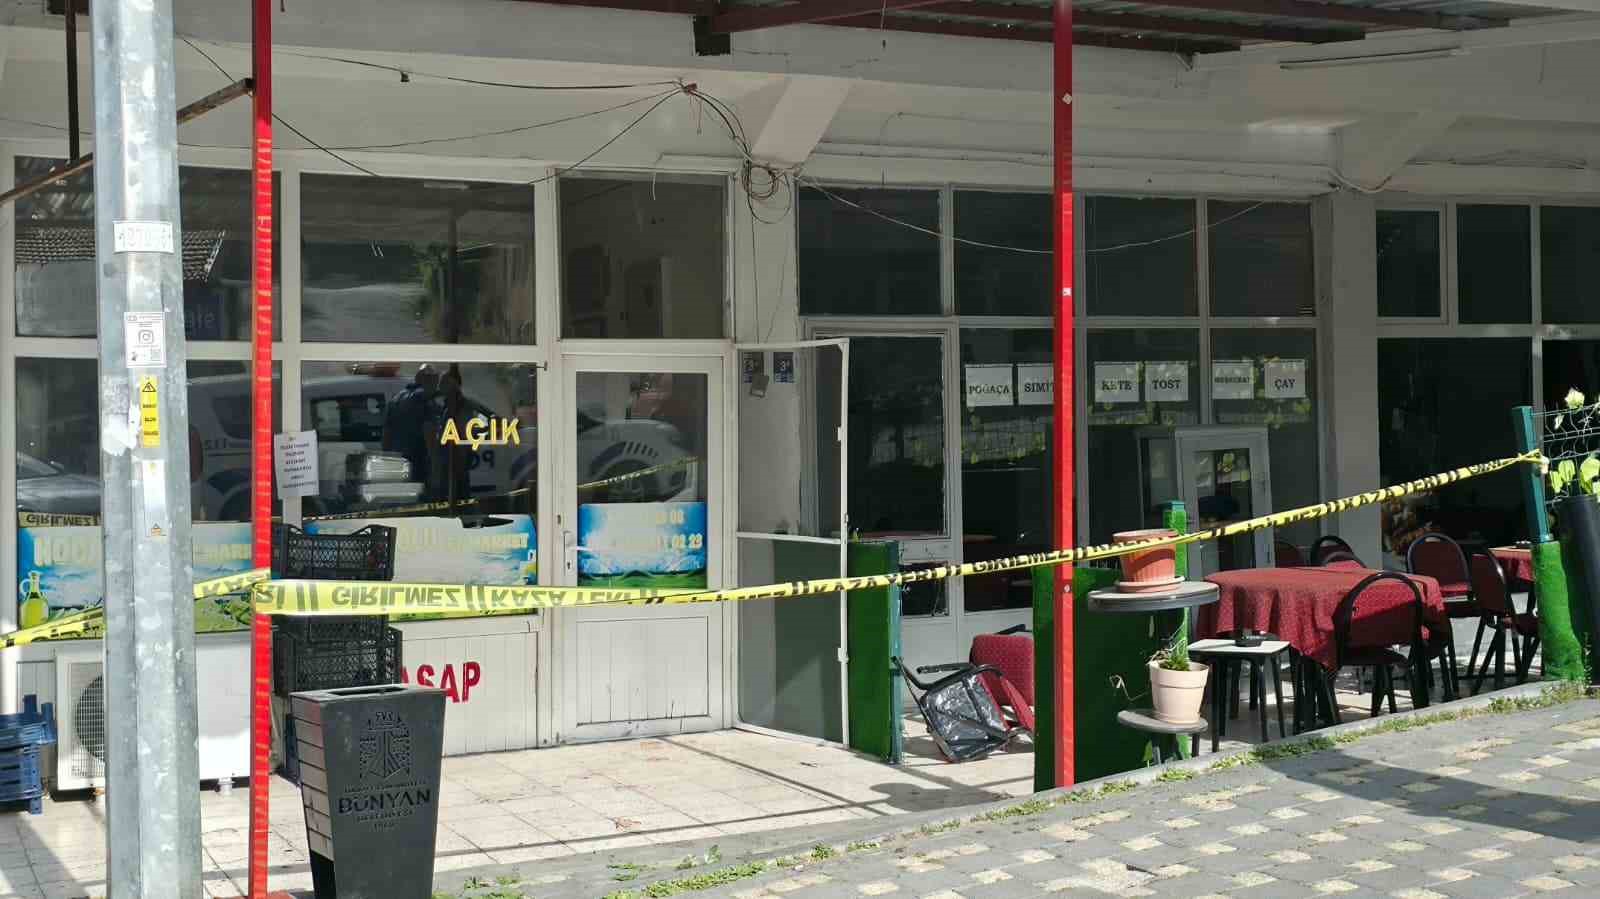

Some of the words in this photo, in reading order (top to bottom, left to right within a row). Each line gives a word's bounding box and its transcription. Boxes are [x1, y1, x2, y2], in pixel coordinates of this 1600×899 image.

[1152, 379, 1181, 390] TOST
[1274, 379, 1296, 390] ÇAY
[440, 417, 520, 451] AÇIK
[338, 788, 432, 815] BÜNYAN
